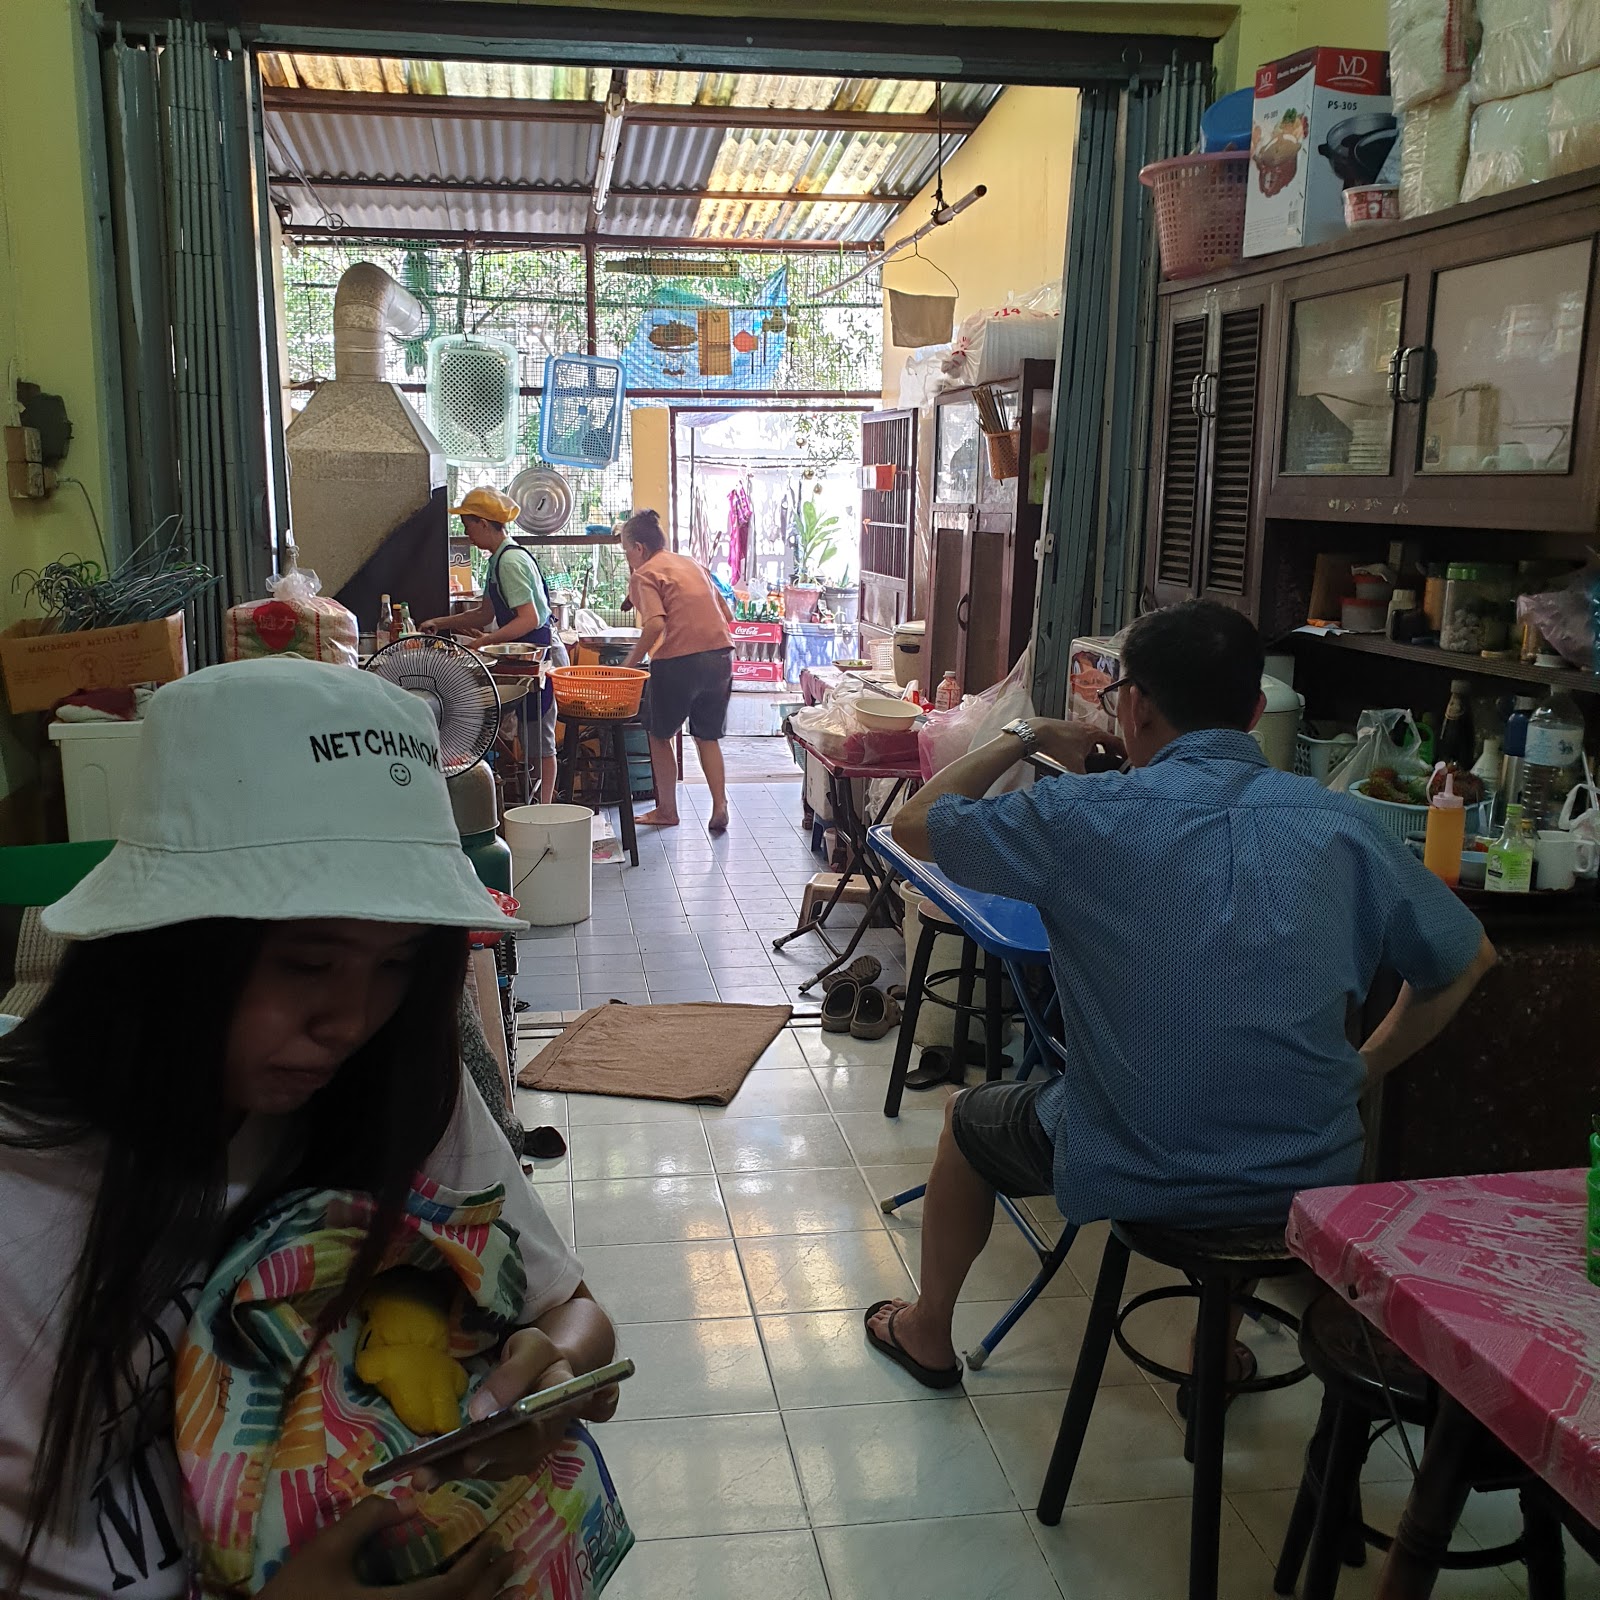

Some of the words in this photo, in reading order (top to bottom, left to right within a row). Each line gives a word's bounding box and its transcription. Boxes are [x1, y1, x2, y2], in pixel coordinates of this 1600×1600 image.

[1338, 55, 1367, 76] MD
[1327, 100, 1358, 111] PS-305
[309, 729, 440, 770] NETCHANOK
